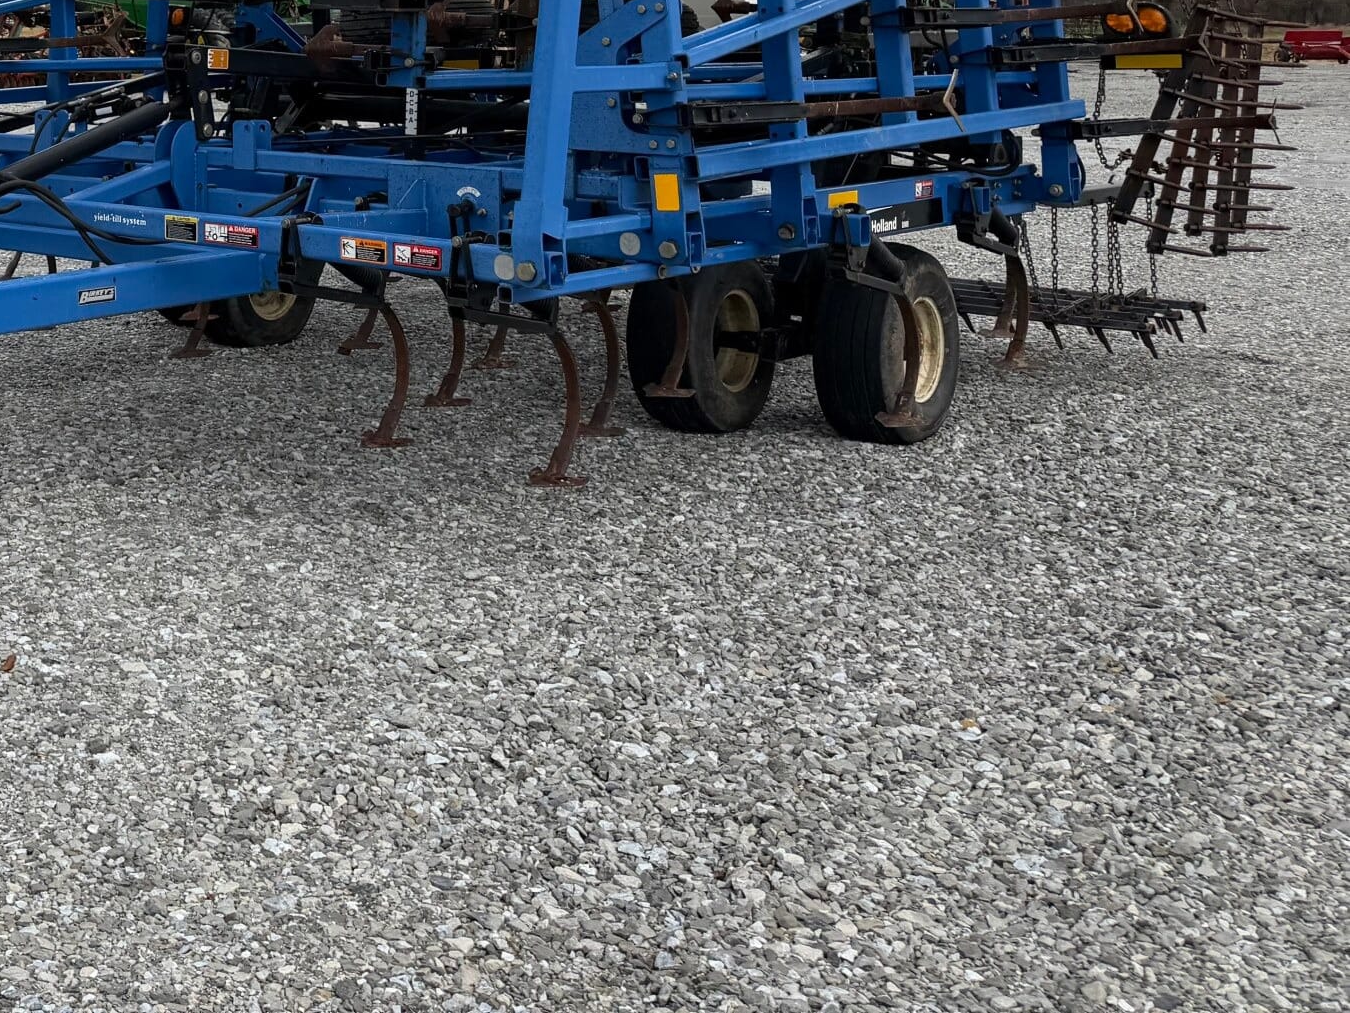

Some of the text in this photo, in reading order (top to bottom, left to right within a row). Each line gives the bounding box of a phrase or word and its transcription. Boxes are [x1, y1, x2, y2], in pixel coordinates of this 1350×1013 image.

[122, 217, 147, 226] system
[871, 216, 897, 234] Holland
[235, 226, 256, 234] DANGER
